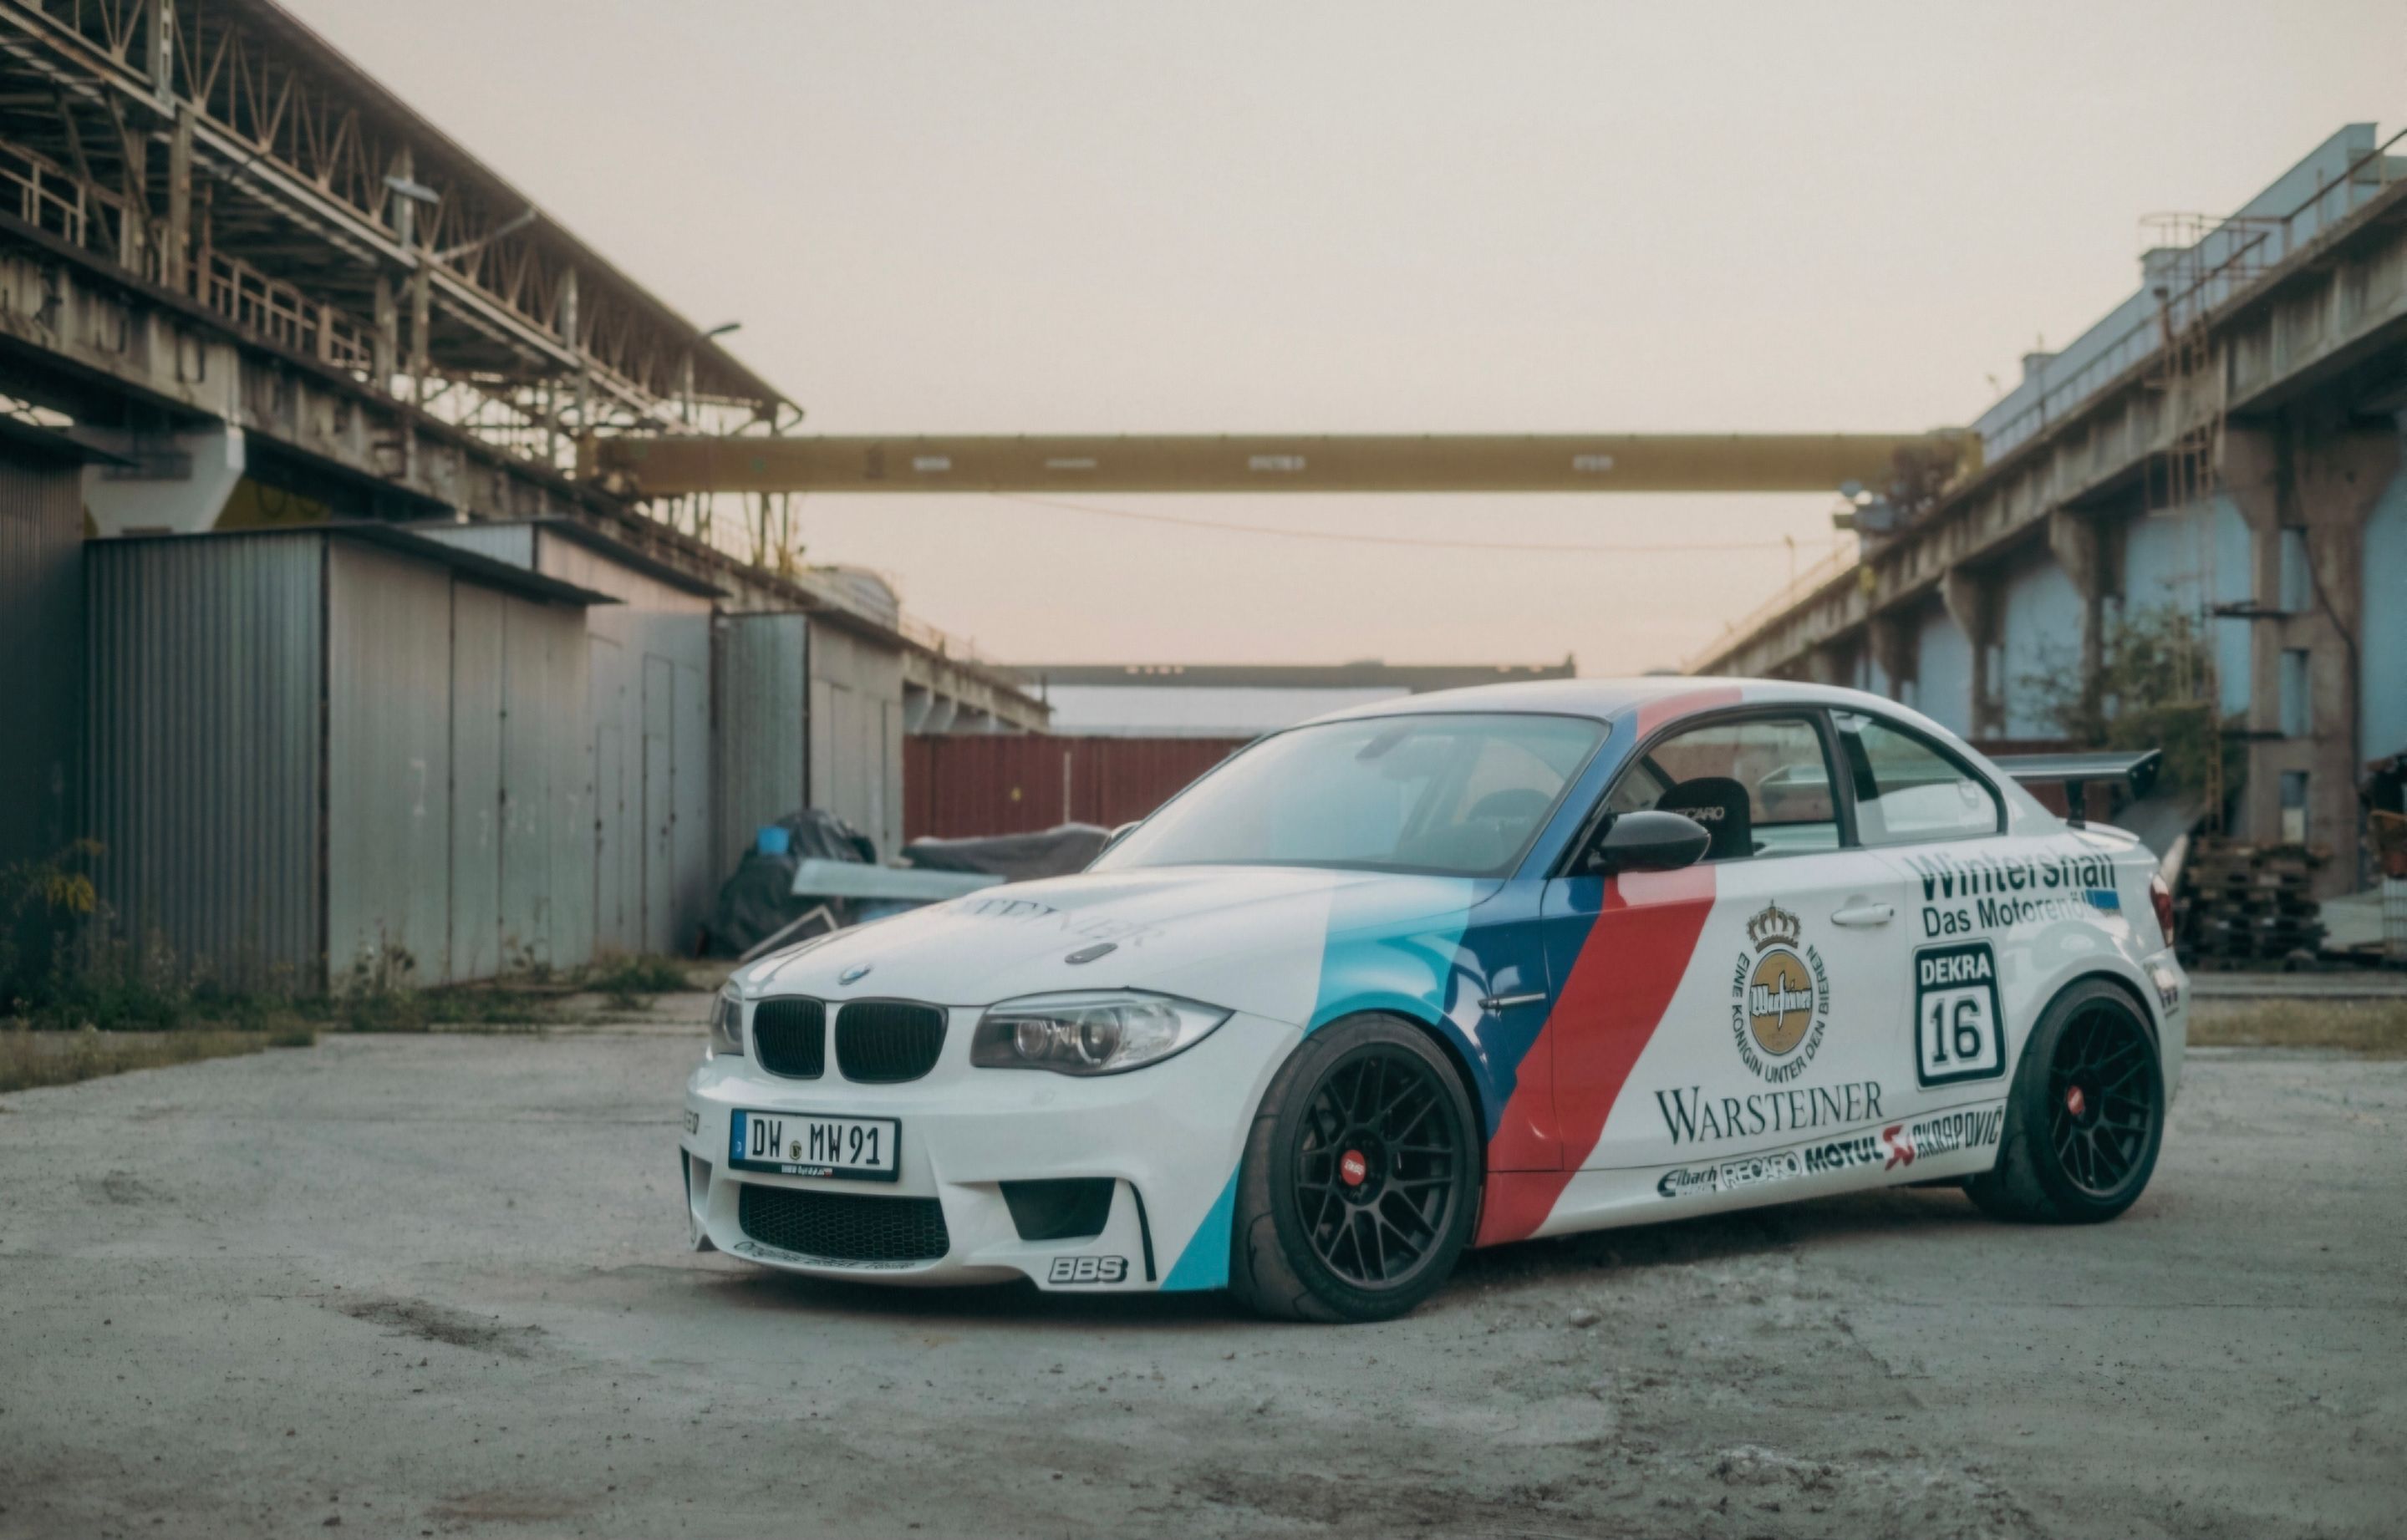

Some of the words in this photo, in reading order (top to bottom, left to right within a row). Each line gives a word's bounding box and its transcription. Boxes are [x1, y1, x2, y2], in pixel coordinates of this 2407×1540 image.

[1670, 806, 1725, 821] CARO
[1903, 846, 2116, 901] Wintershall
[1923, 907, 1972, 938] Das
[1732, 951, 1750, 999] EINE
[1805, 943, 1829, 1015] BIEREN
[1921, 953, 1992, 986] DEKRA
[1804, 1019, 1826, 1061] DEN
[1930, 994, 1985, 1067] 16
[1764, 1055, 1808, 1084] UNTER
[1654, 1081, 1884, 1146] WARSTEINER
[752, 1118, 782, 1158] DW
[1657, 1165, 1717, 1198] Eibach
[1722, 1151, 1800, 1190] RECARO
[1804, 1136, 1885, 1174] MOTUL
[1048, 1255, 1128, 1284] BBS
